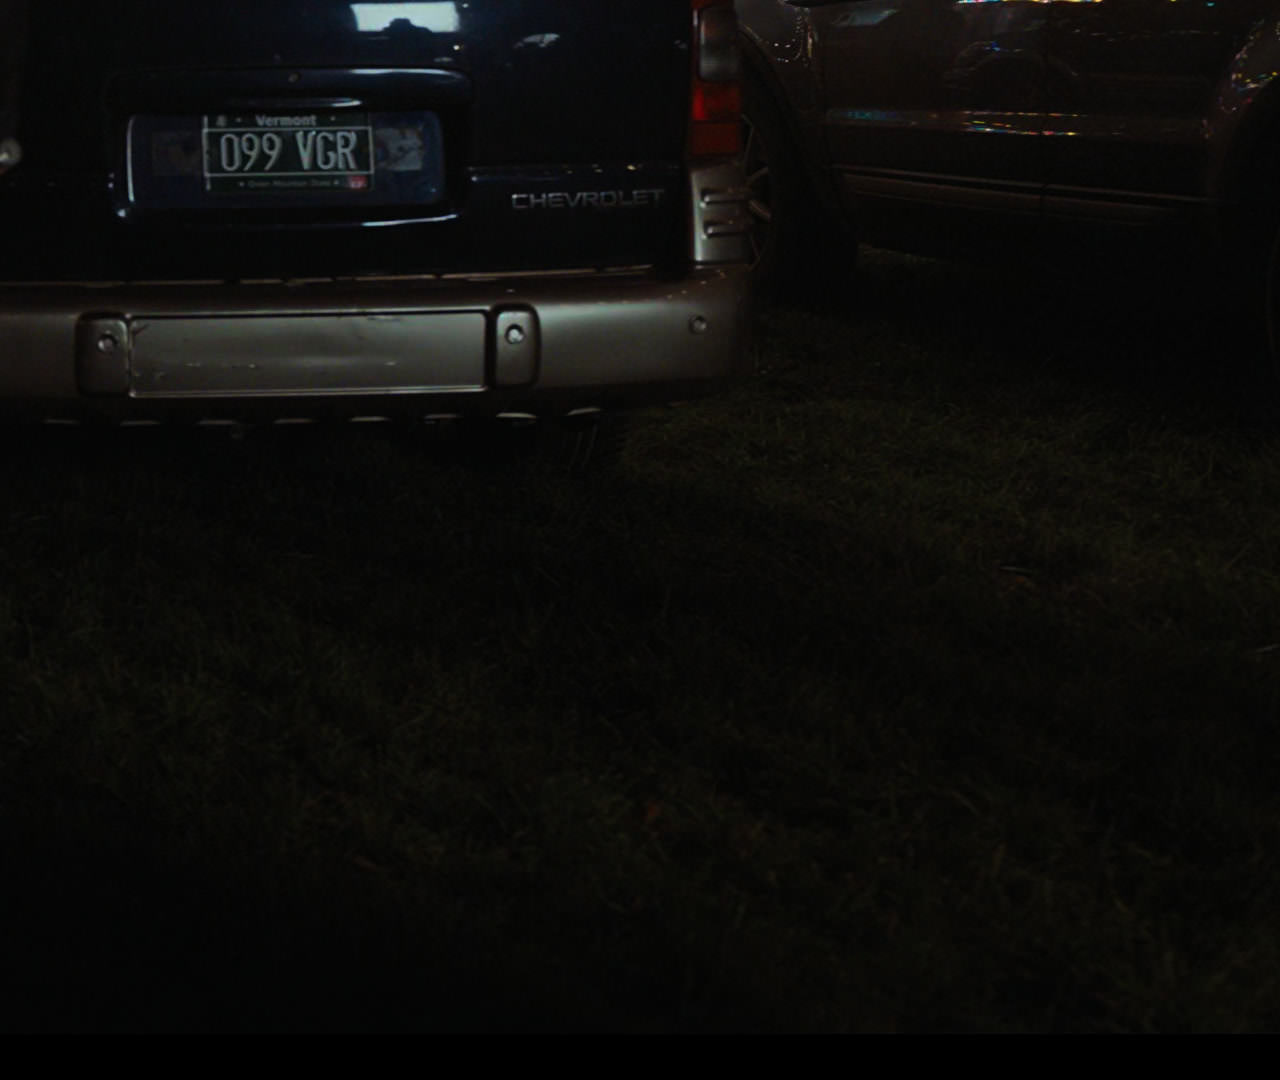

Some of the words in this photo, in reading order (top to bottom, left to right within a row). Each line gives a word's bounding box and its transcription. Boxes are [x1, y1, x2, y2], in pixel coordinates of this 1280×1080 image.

[255, 114, 317, 127] Vermont
[220, 133, 282, 172] 099
[295, 131, 358, 171] VGR
[511, 188, 665, 209] CHEVROLET
